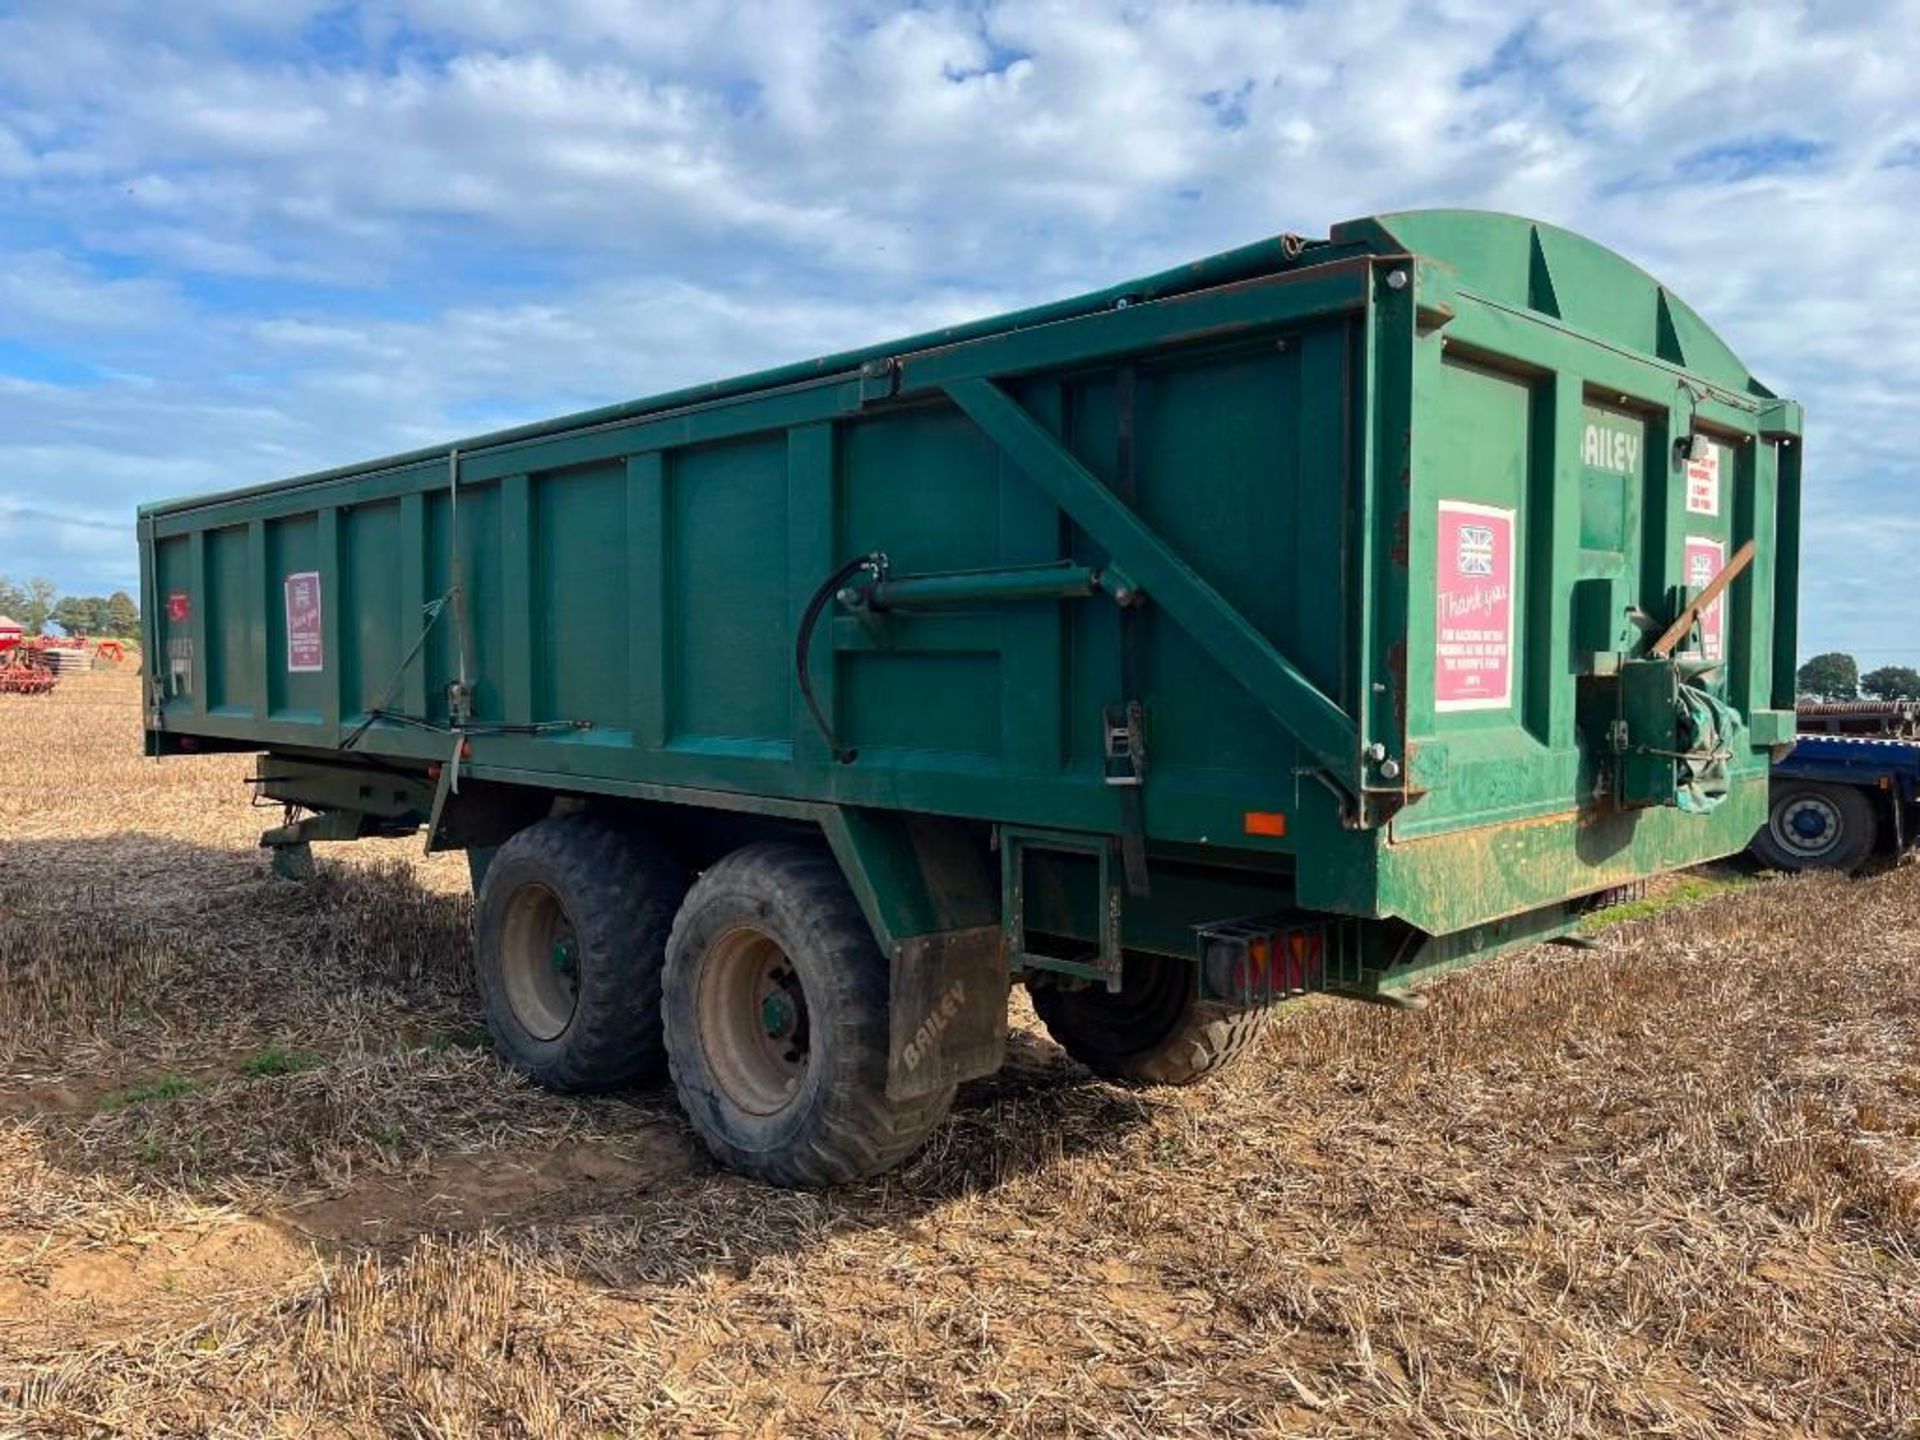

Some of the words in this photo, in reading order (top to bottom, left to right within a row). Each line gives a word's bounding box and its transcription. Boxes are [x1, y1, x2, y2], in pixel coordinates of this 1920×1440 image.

[1581, 424, 1638, 474] AILEY
[1438, 584, 1484, 621] Thank
[1484, 584, 1507, 618] you
[1442, 628, 1454, 641] FOR
[1455, 629, 1482, 641] BACKING
[1444, 658, 1456, 671] THE
[903, 979, 966, 1073] BAILEY
